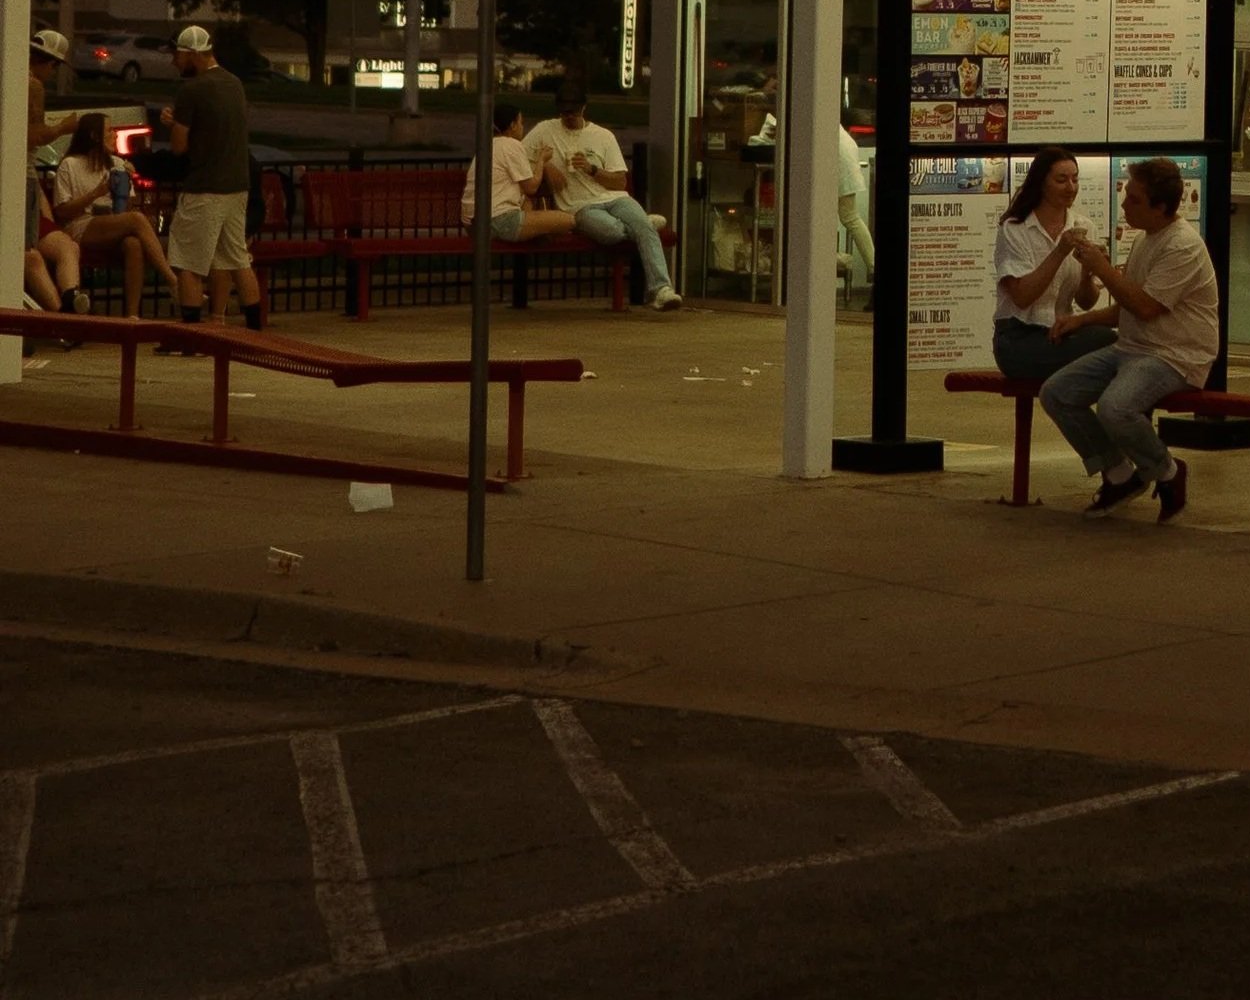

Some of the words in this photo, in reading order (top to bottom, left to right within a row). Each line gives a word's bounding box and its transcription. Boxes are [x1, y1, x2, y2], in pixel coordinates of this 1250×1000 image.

[914, 17, 949, 29] EMON
[915, 31, 941, 43] BAR
[1114, 64, 1135, 78] WAFFLE
[909, 158, 935, 174] STONE
[943, 203, 963, 217] SPLITS
[909, 310, 928, 324] SMALL
[929, 309, 951, 323] TREATS
